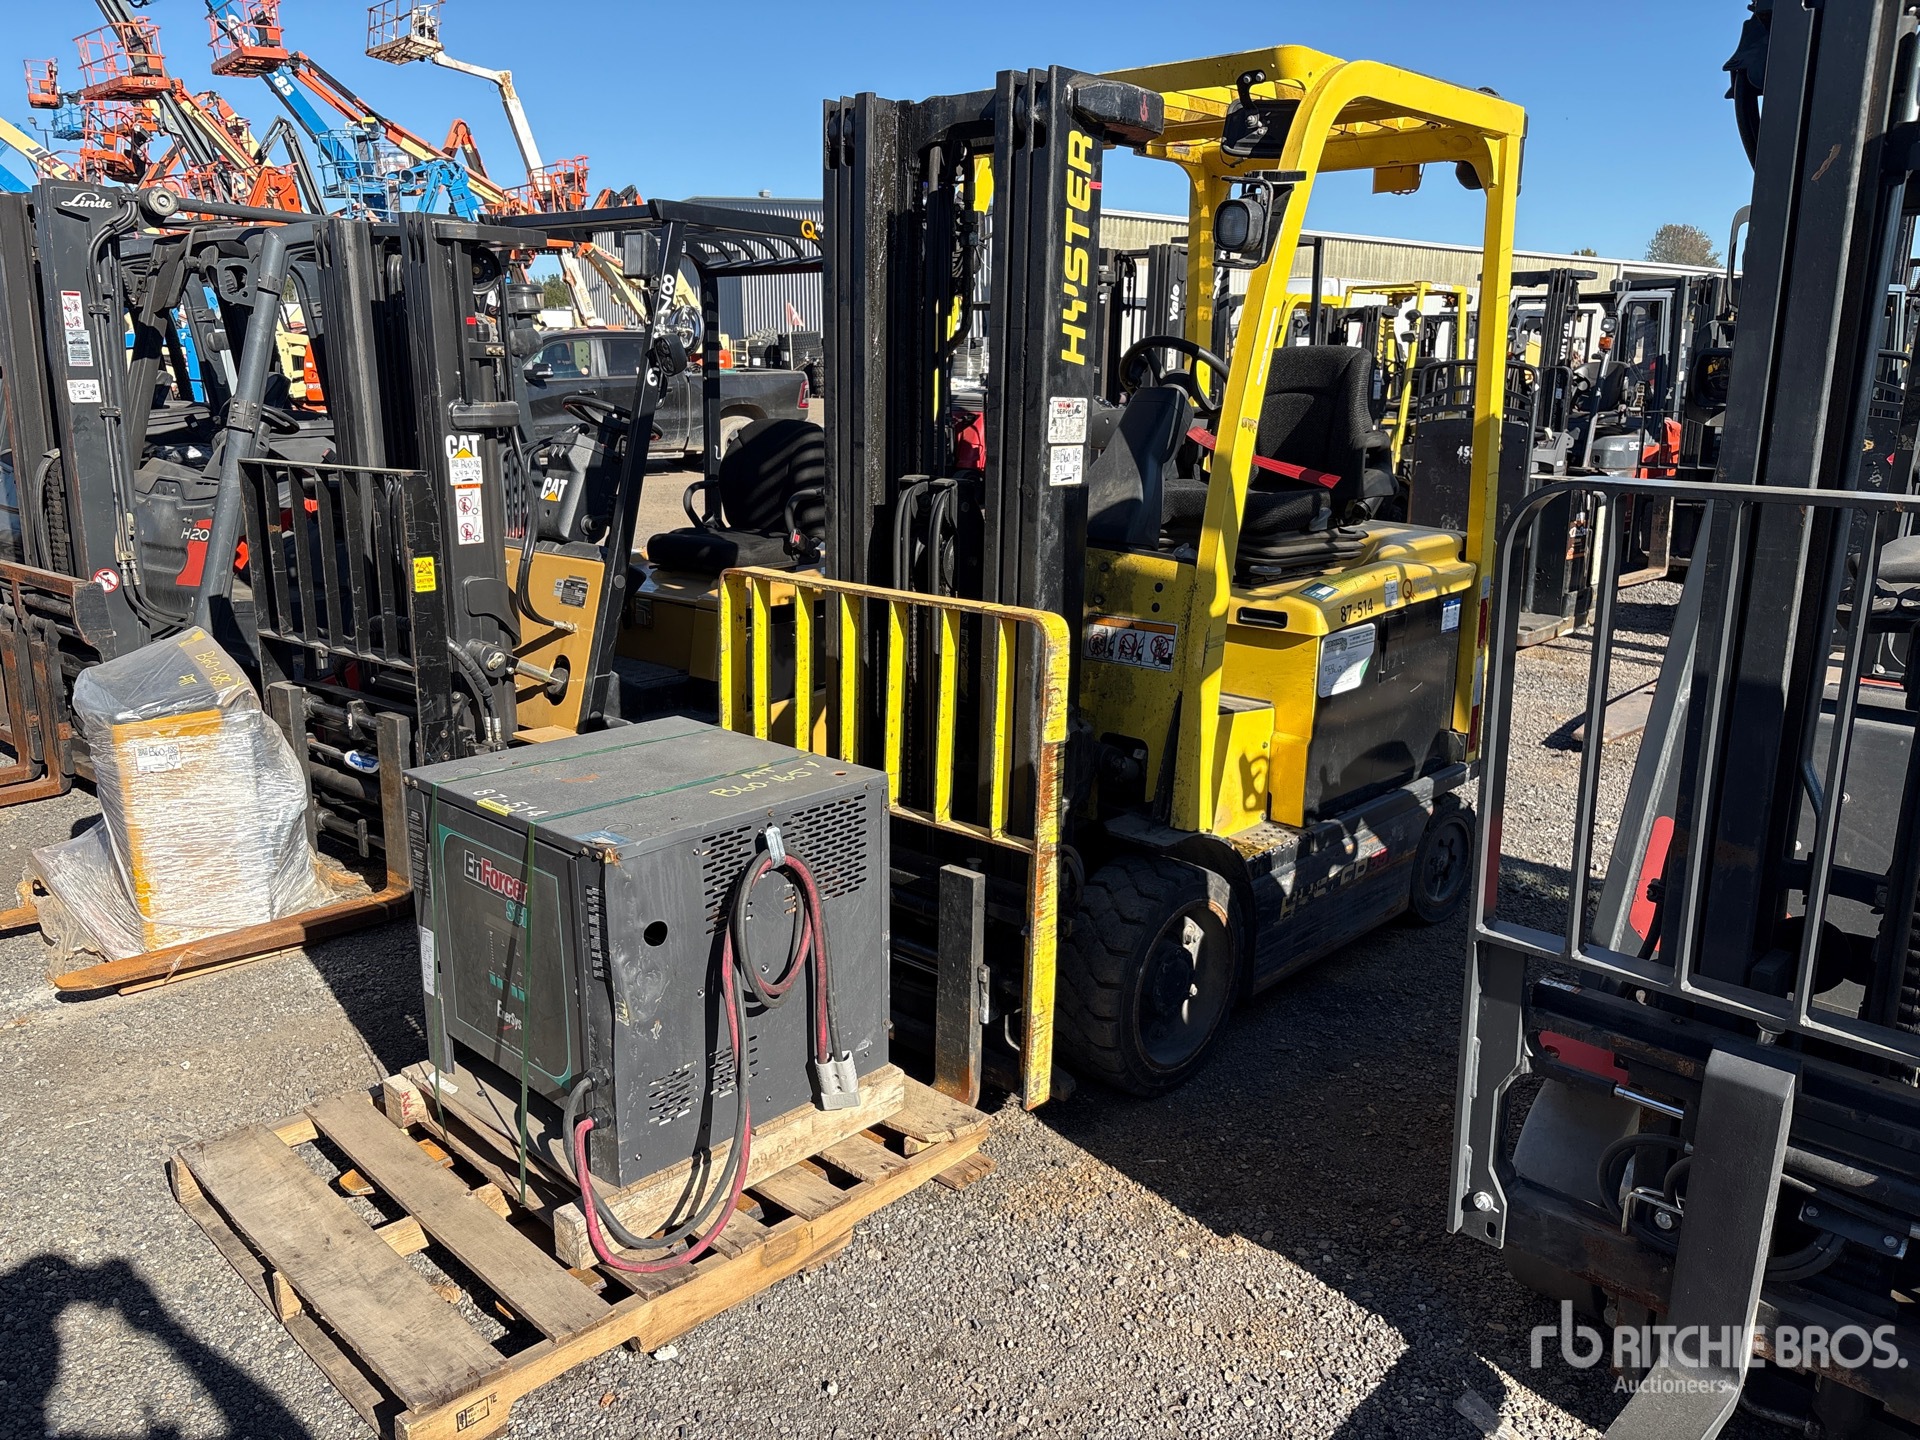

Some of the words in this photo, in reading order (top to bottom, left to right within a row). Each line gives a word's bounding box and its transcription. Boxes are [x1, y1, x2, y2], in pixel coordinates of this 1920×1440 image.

[61, 192, 113, 209] Linde
[1061, 129, 1093, 366] HYSTER
[1169, 283, 1180, 322] Yale
[445, 434, 481, 459] CAT
[540, 477, 569, 502] CAT
[180, 527, 211, 542] H20
[1340, 598, 1374, 622] 87-514
[472, 788, 549, 817] 87-514
[464, 849, 529, 905] EnForcer
